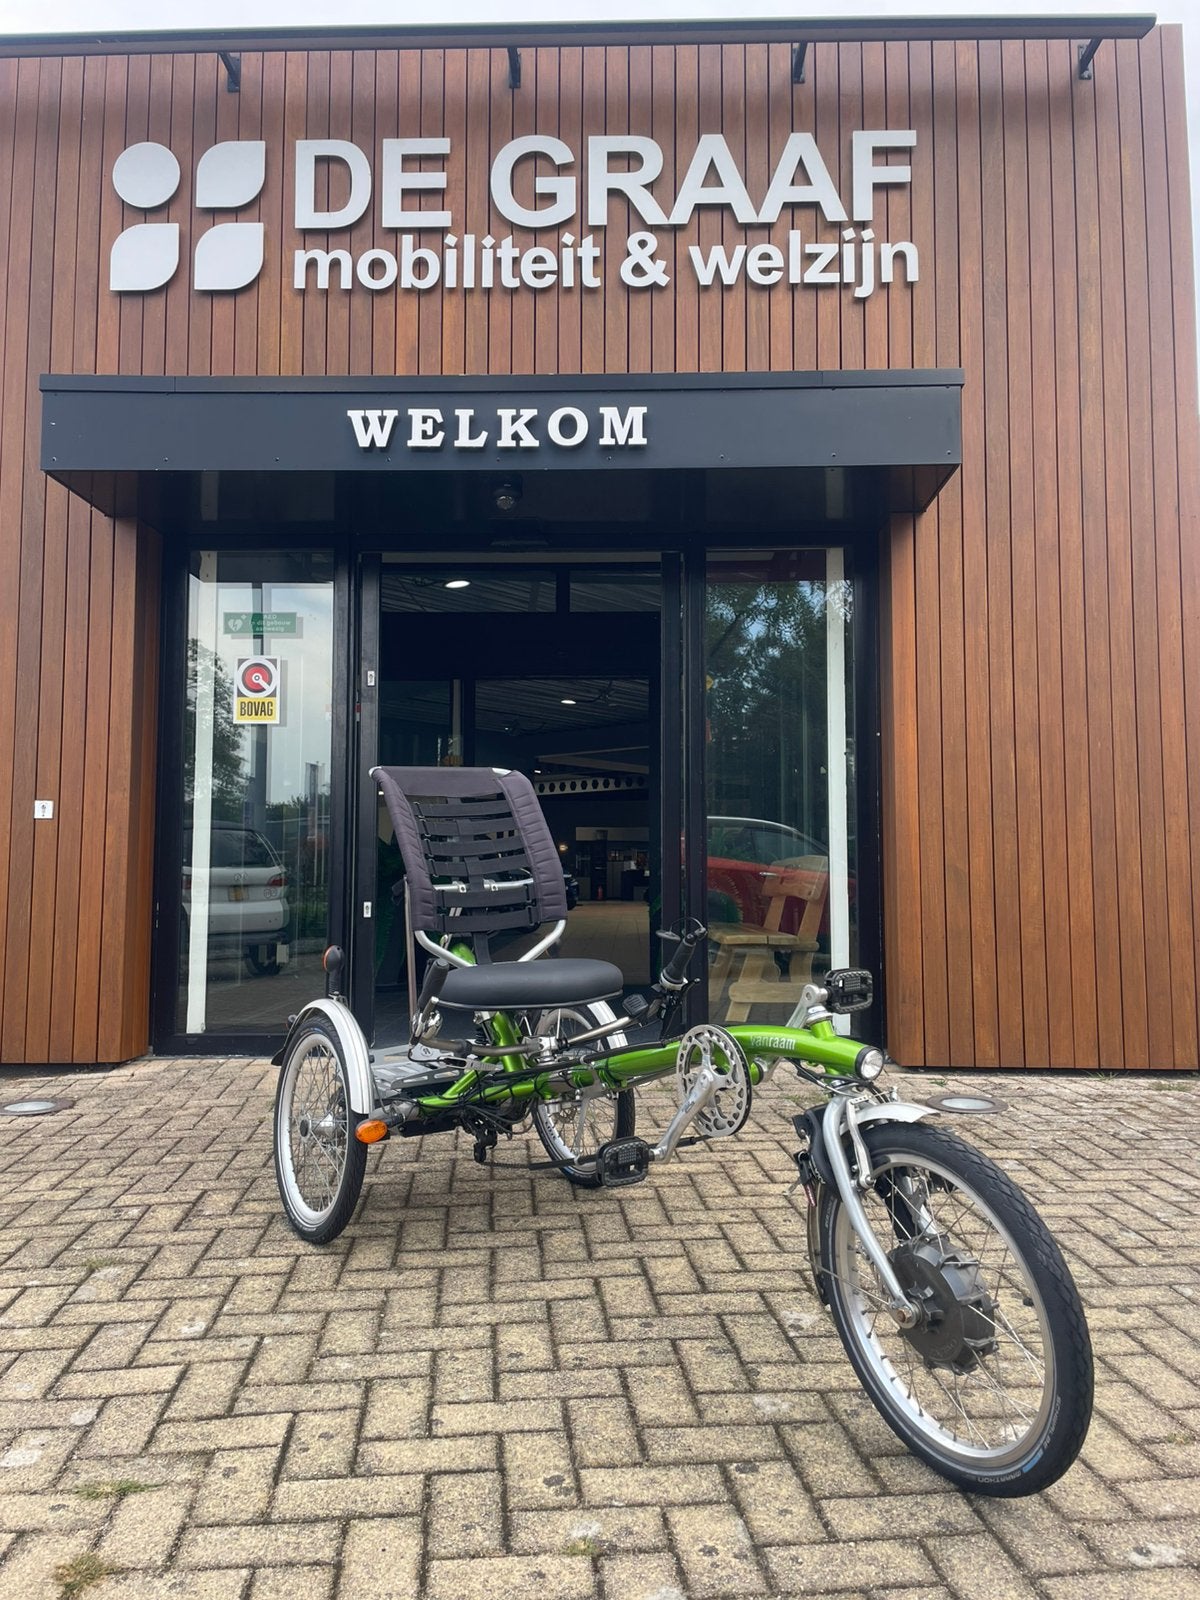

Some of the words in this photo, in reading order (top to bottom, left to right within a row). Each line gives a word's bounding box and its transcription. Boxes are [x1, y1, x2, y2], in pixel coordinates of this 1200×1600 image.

[295, 137, 452, 229] DE
[490, 129, 917, 228] GRAAF
[294, 231, 601, 290] mobiliteit
[620, 231, 671, 288] &
[688, 227, 919, 298] welzijn
[347, 406, 648, 448] WELKOM
[240, 701, 274, 717] BOVAG
